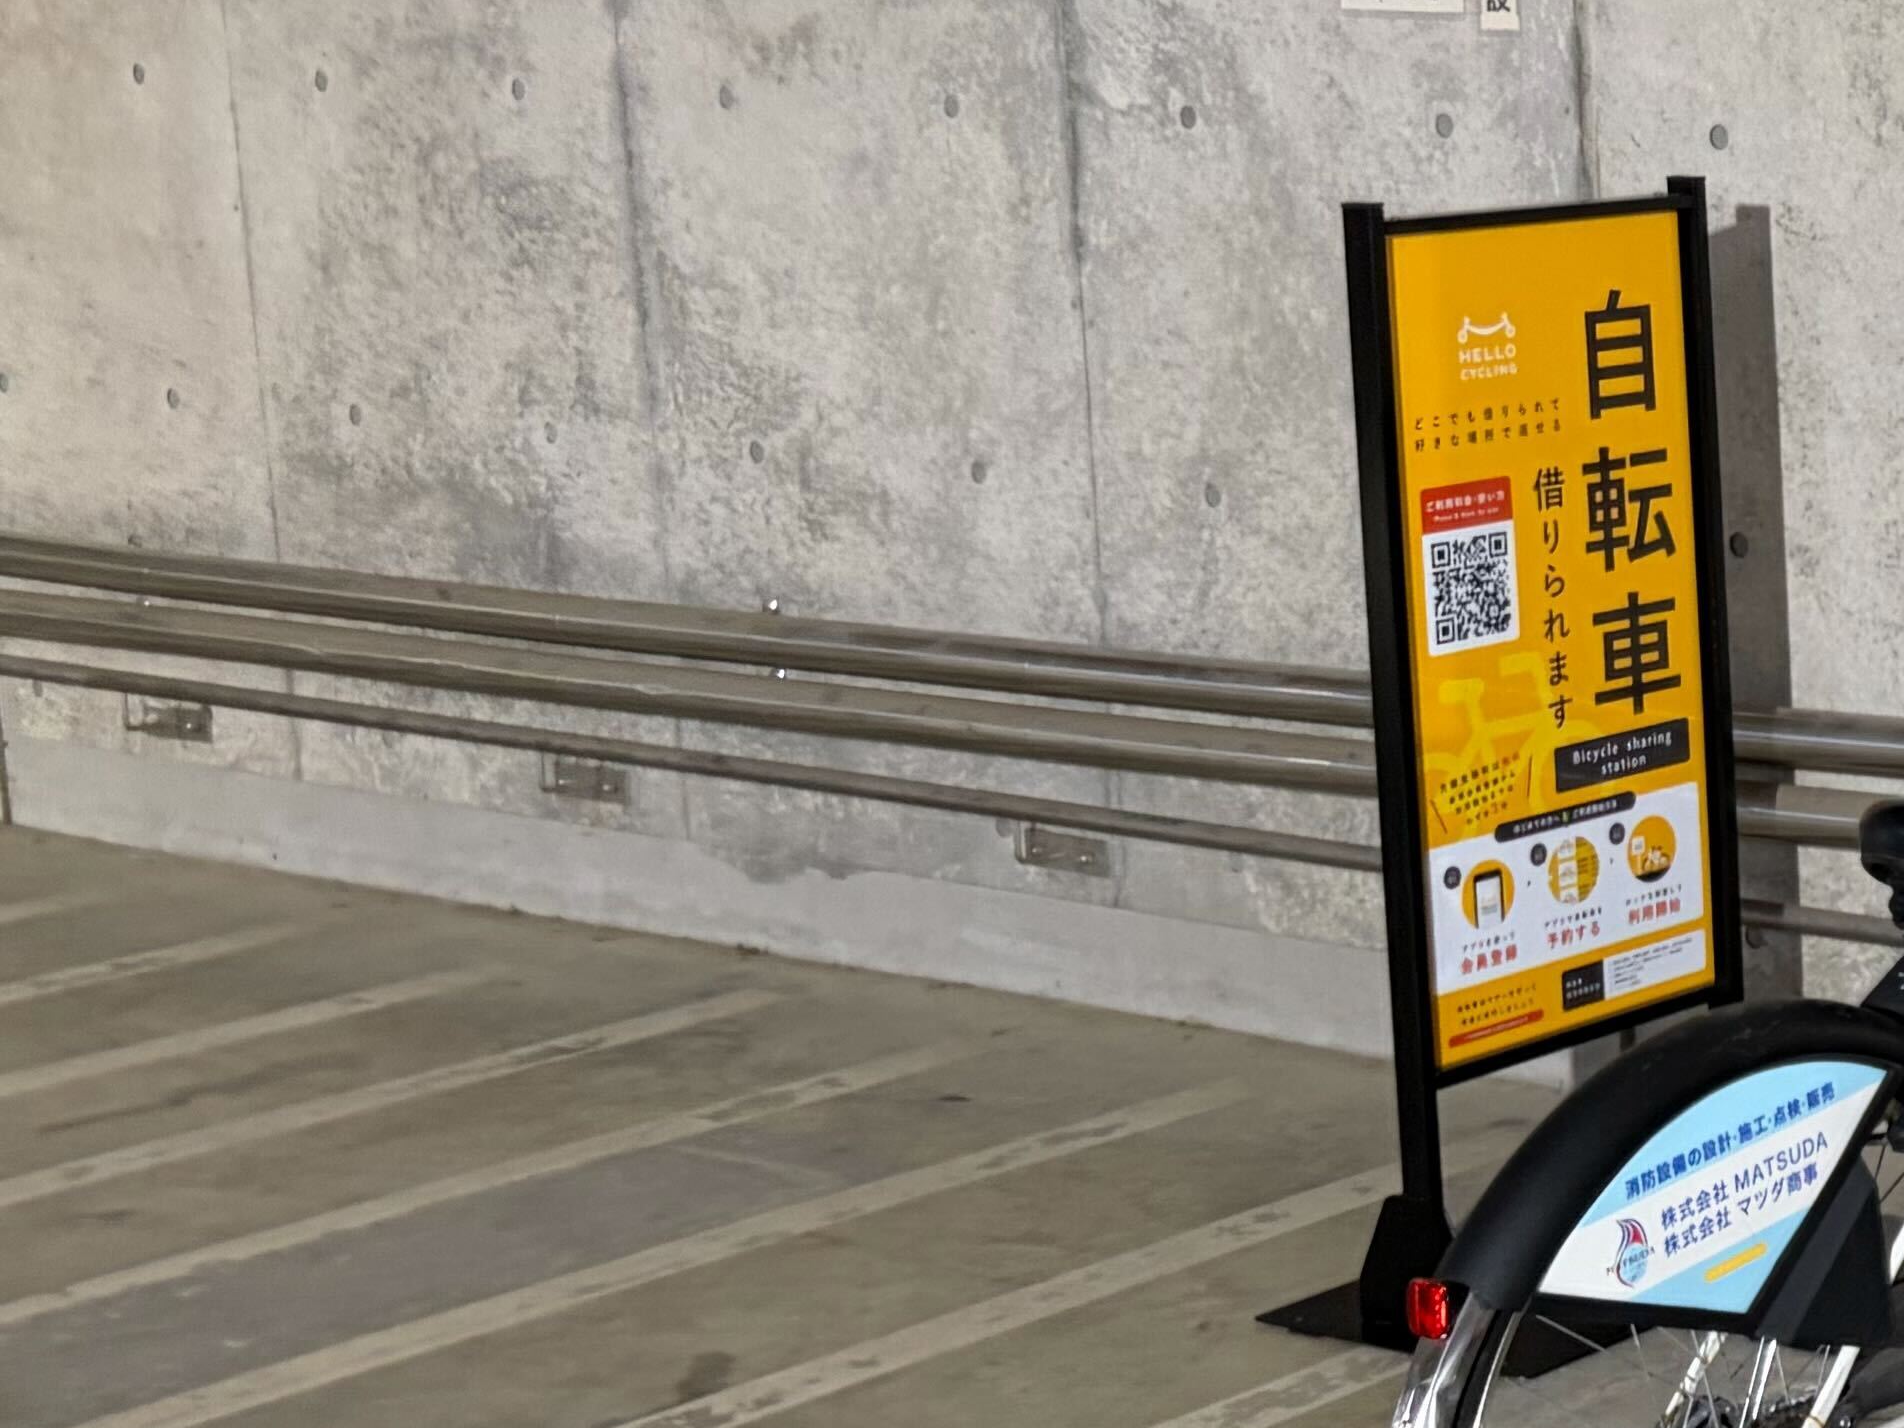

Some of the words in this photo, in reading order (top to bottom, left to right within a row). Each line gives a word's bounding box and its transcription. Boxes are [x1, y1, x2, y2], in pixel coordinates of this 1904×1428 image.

[1458, 343, 1517, 364] HELLO
[1460, 362, 1518, 381] CYCLING
[1582, 289, 1682, 715] 自転車
[1533, 467, 1573, 730] 借りられます
[1572, 742, 1619, 765] Bicycle
[1627, 731, 1672, 752] sharing
[1601, 754, 1647, 775] station
[1547, 921, 1600, 950] 予約する
[1661, 1180, 1730, 1230] 株式会社
[1734, 1131, 1828, 1193] MATSUDA
[1664, 1206, 1732, 1258] 株式会社
[1738, 1162, 1818, 1216] マツダ商事
